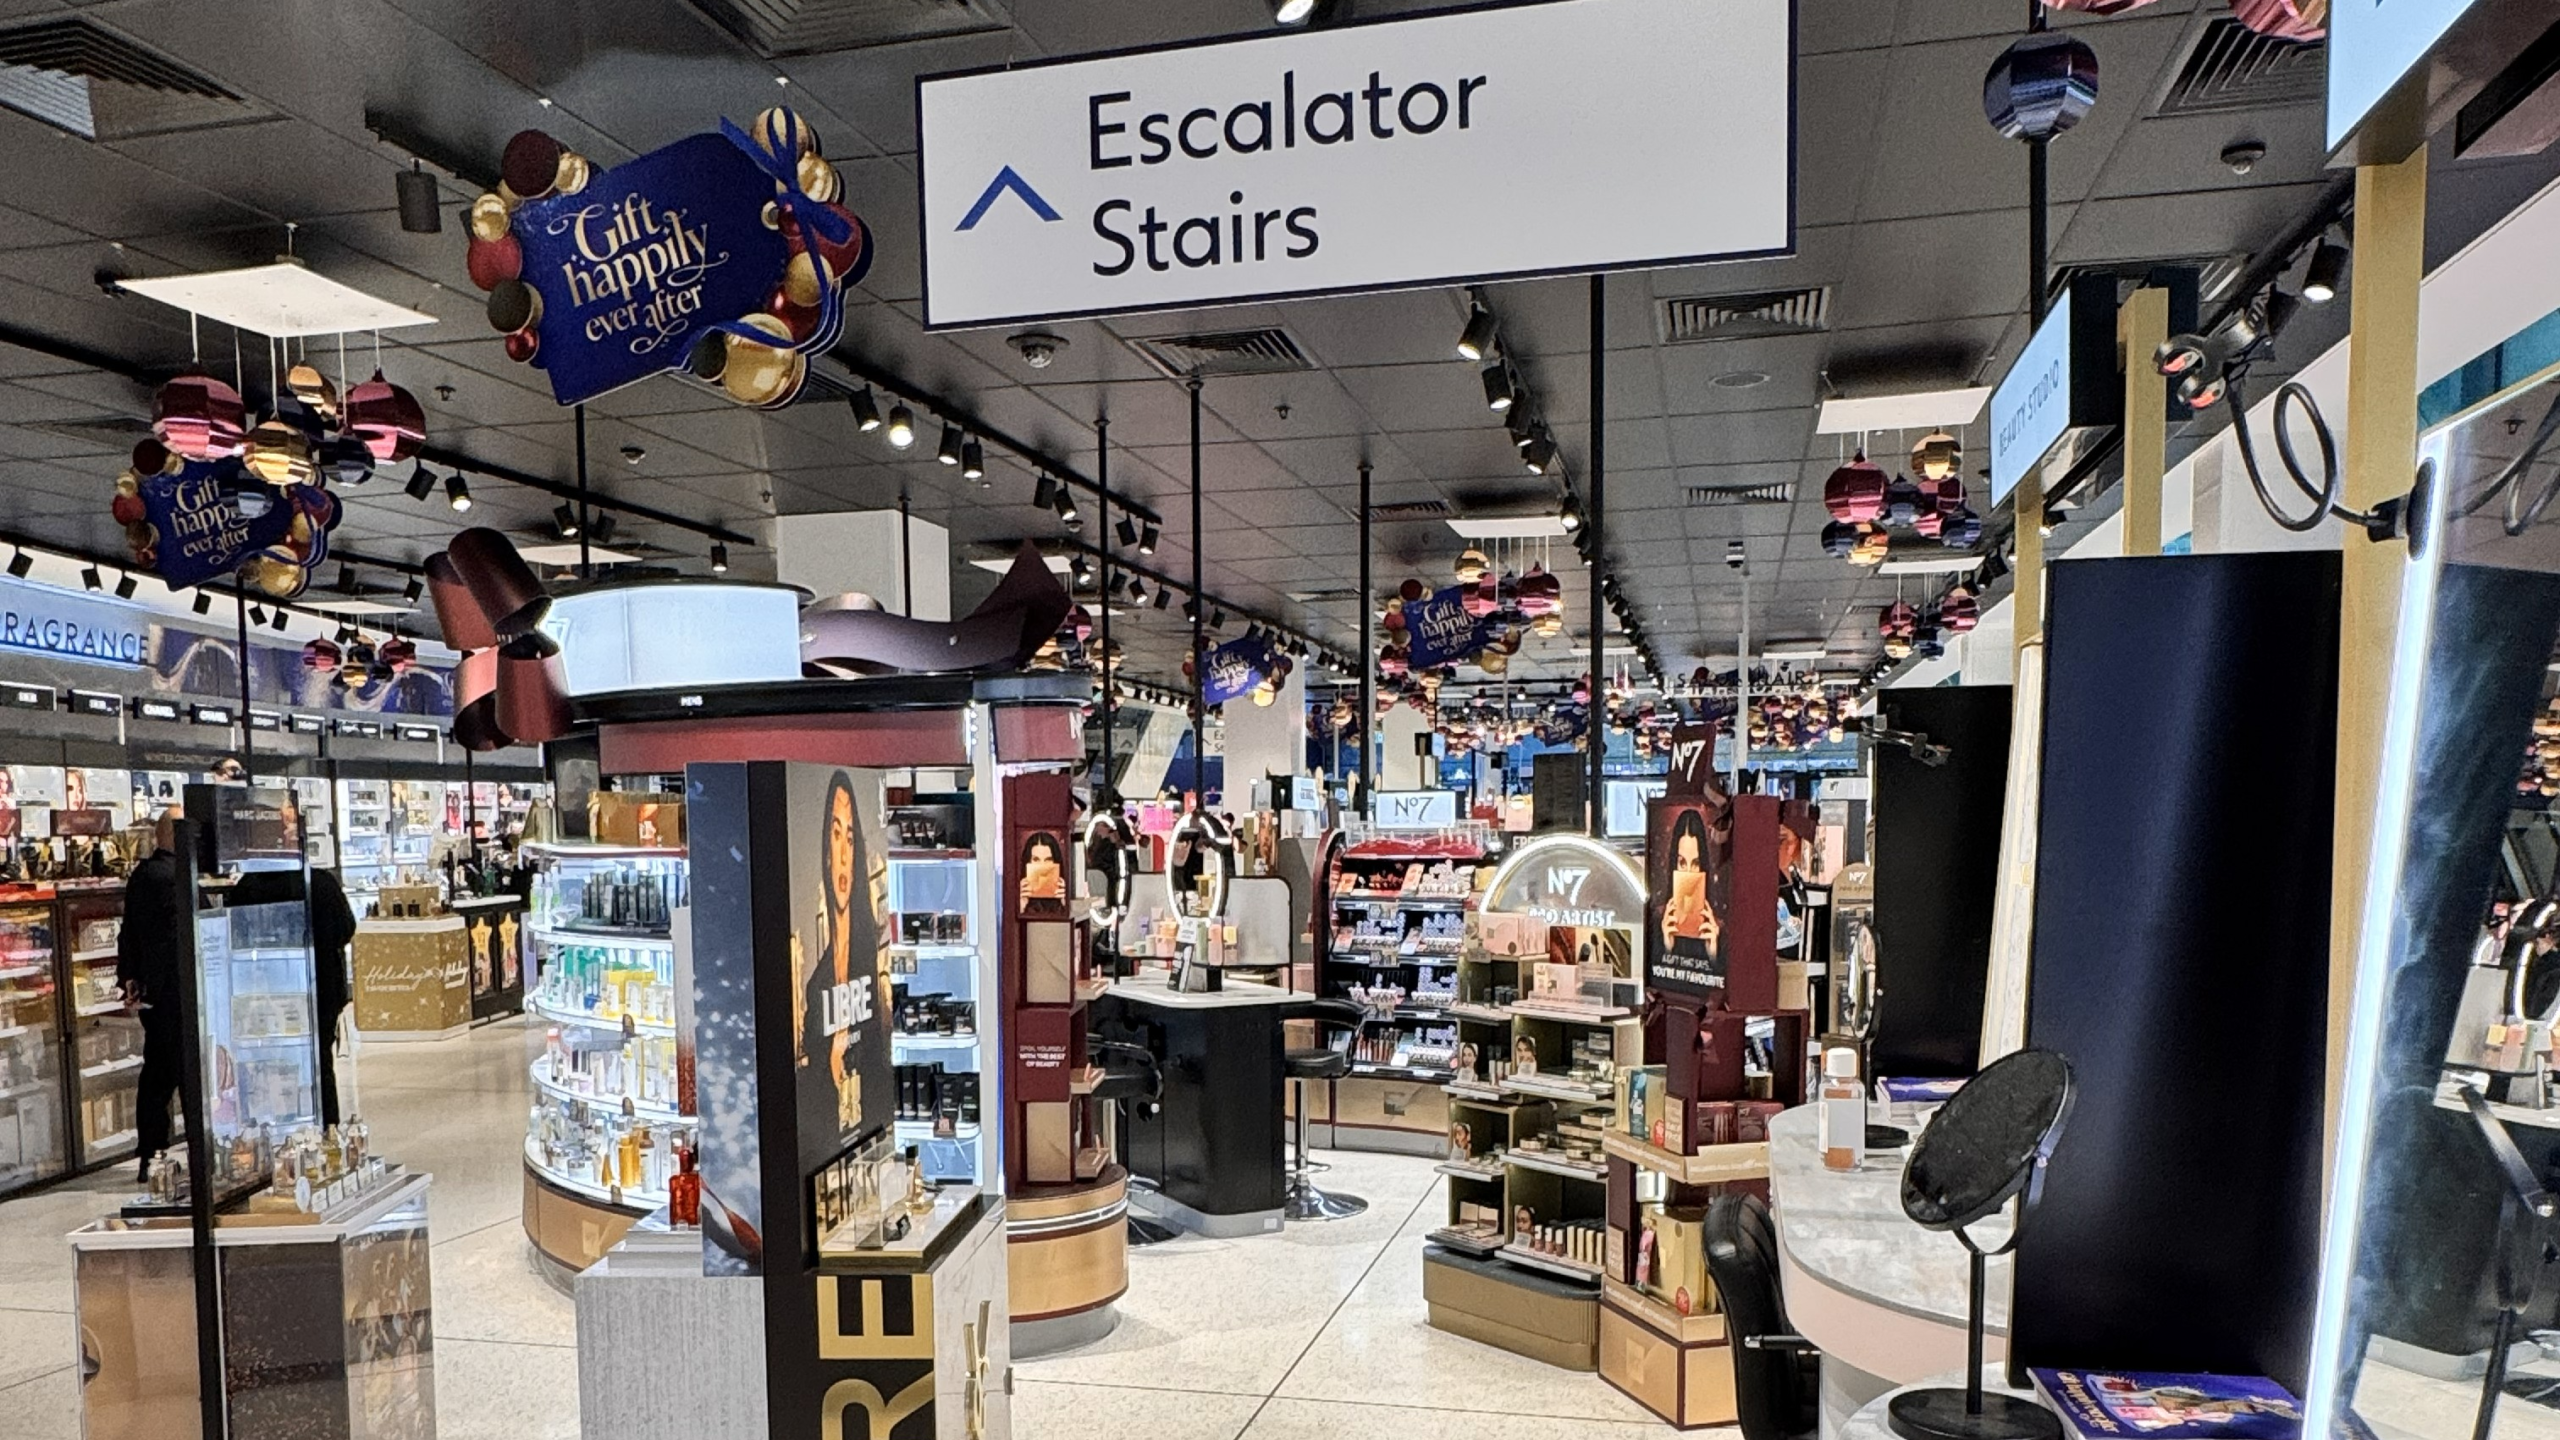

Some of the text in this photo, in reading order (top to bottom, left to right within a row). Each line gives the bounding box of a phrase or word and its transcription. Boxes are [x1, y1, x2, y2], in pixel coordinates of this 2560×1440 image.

[1089, 70, 1487, 170] Escalator
[547, 192, 662, 262] Gift
[562, 210, 729, 307] happily
[1092, 190, 1320, 276] Stairs
[585, 283, 702, 348] ever after
[1999, 359, 2059, 458] BEAUTY STUDIO
[172, 475, 220, 513] Gift
[0, 611, 150, 664] RAGRANCE
[1423, 600, 1456, 624] Gift
[1560, 908, 1616, 927] ARTIST
[822, 975, 873, 1037] LIBRE
[1686, 970, 1726, 989] FAVOURITE
